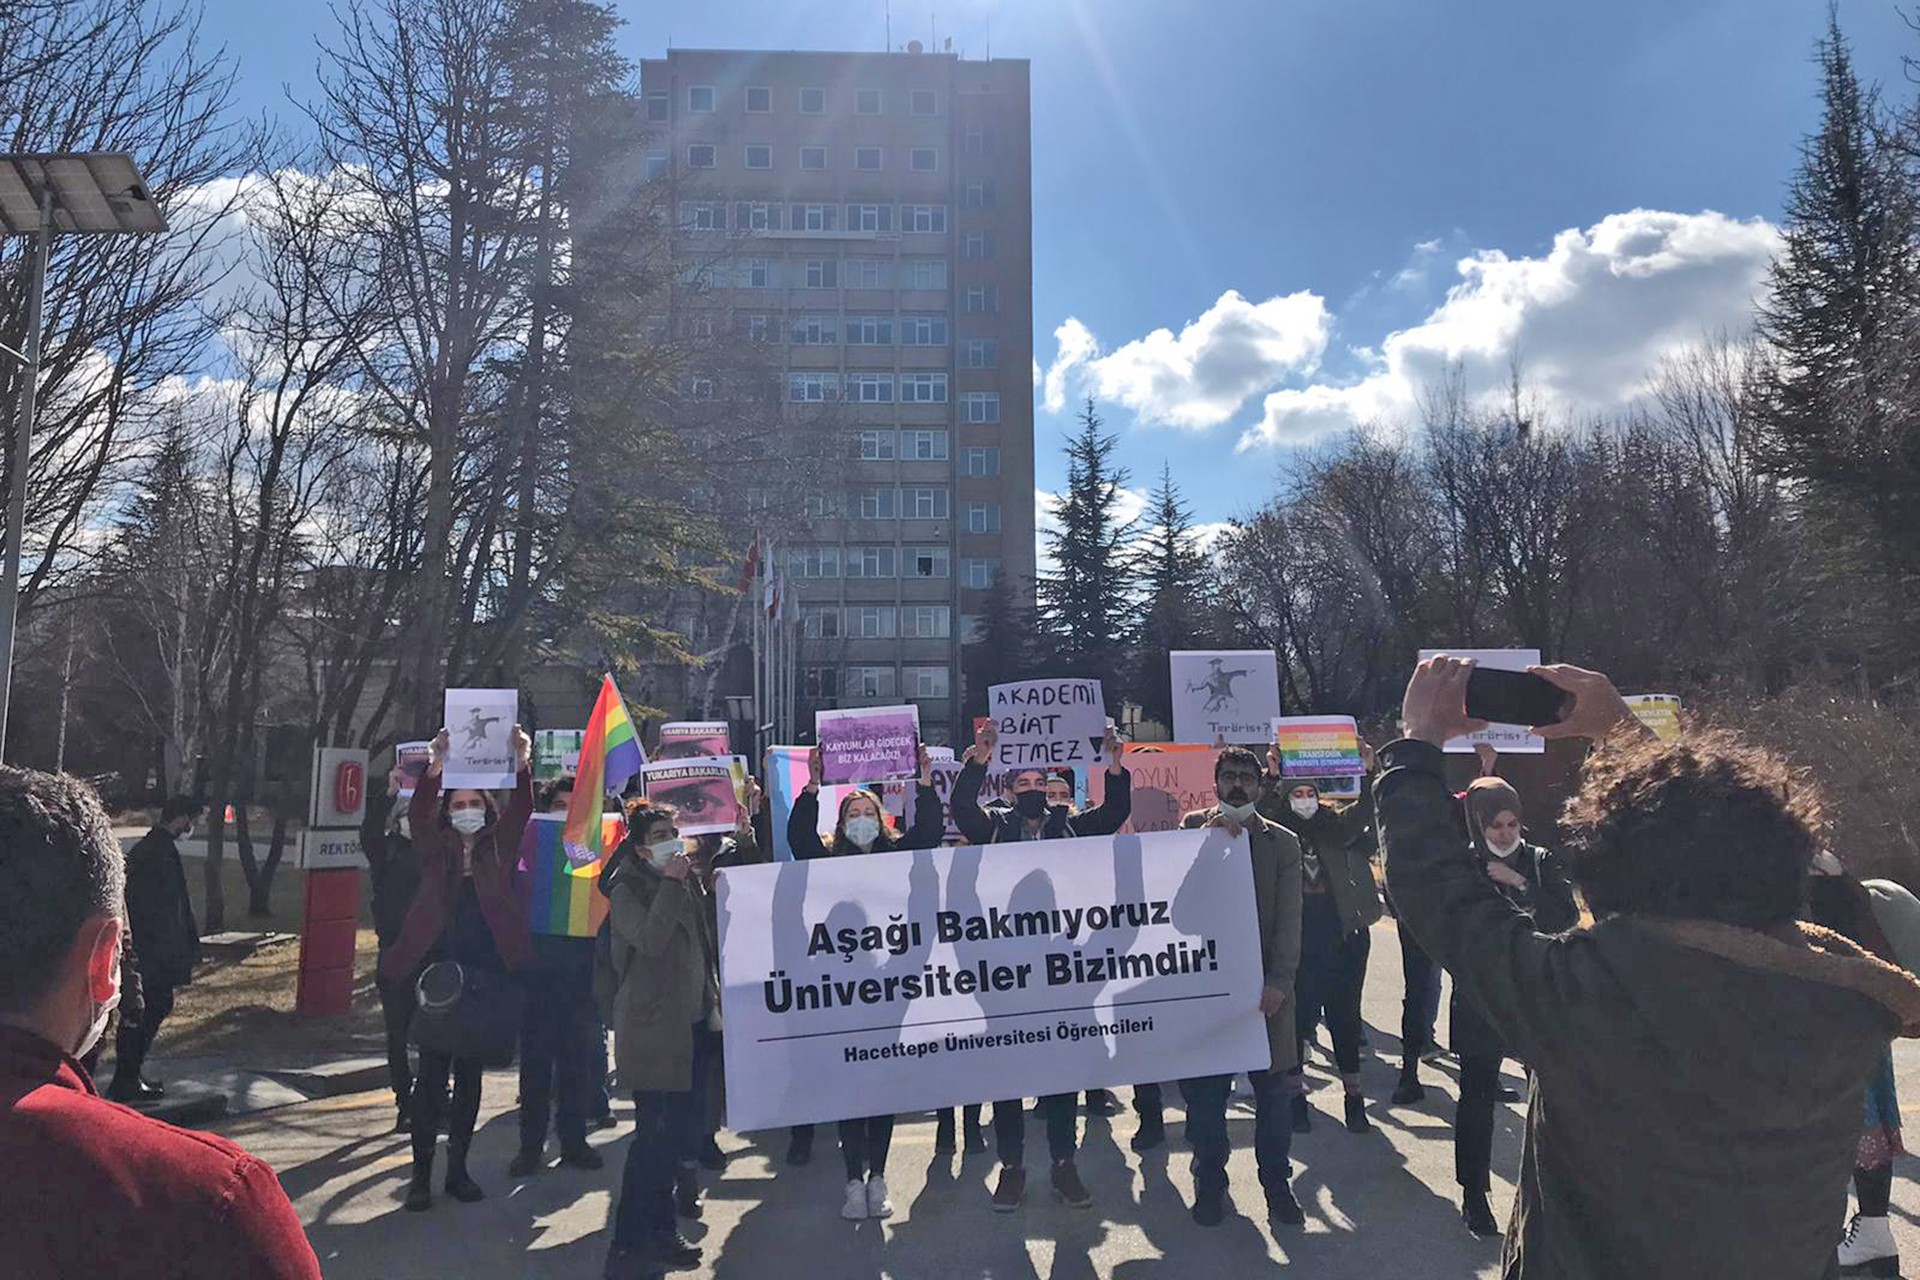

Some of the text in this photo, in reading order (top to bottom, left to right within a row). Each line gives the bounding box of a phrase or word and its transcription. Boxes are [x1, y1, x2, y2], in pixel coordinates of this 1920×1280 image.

[997, 682, 1096, 706] AKADEMİ
[999, 713, 1062, 735] BİAT
[825, 736, 913, 752] KAYYUMLAR GİDECEK
[647, 767, 688, 781] YUKARIYA
[1131, 766, 1179, 790] OYUN
[808, 900, 1170, 963] Aşağı Bakmıyoruz
[765, 939, 1218, 1013] Üniversiteler Bizimdir!
[843, 1015, 1154, 1063] Hacettepe Üniversitesi Öğrencileri
